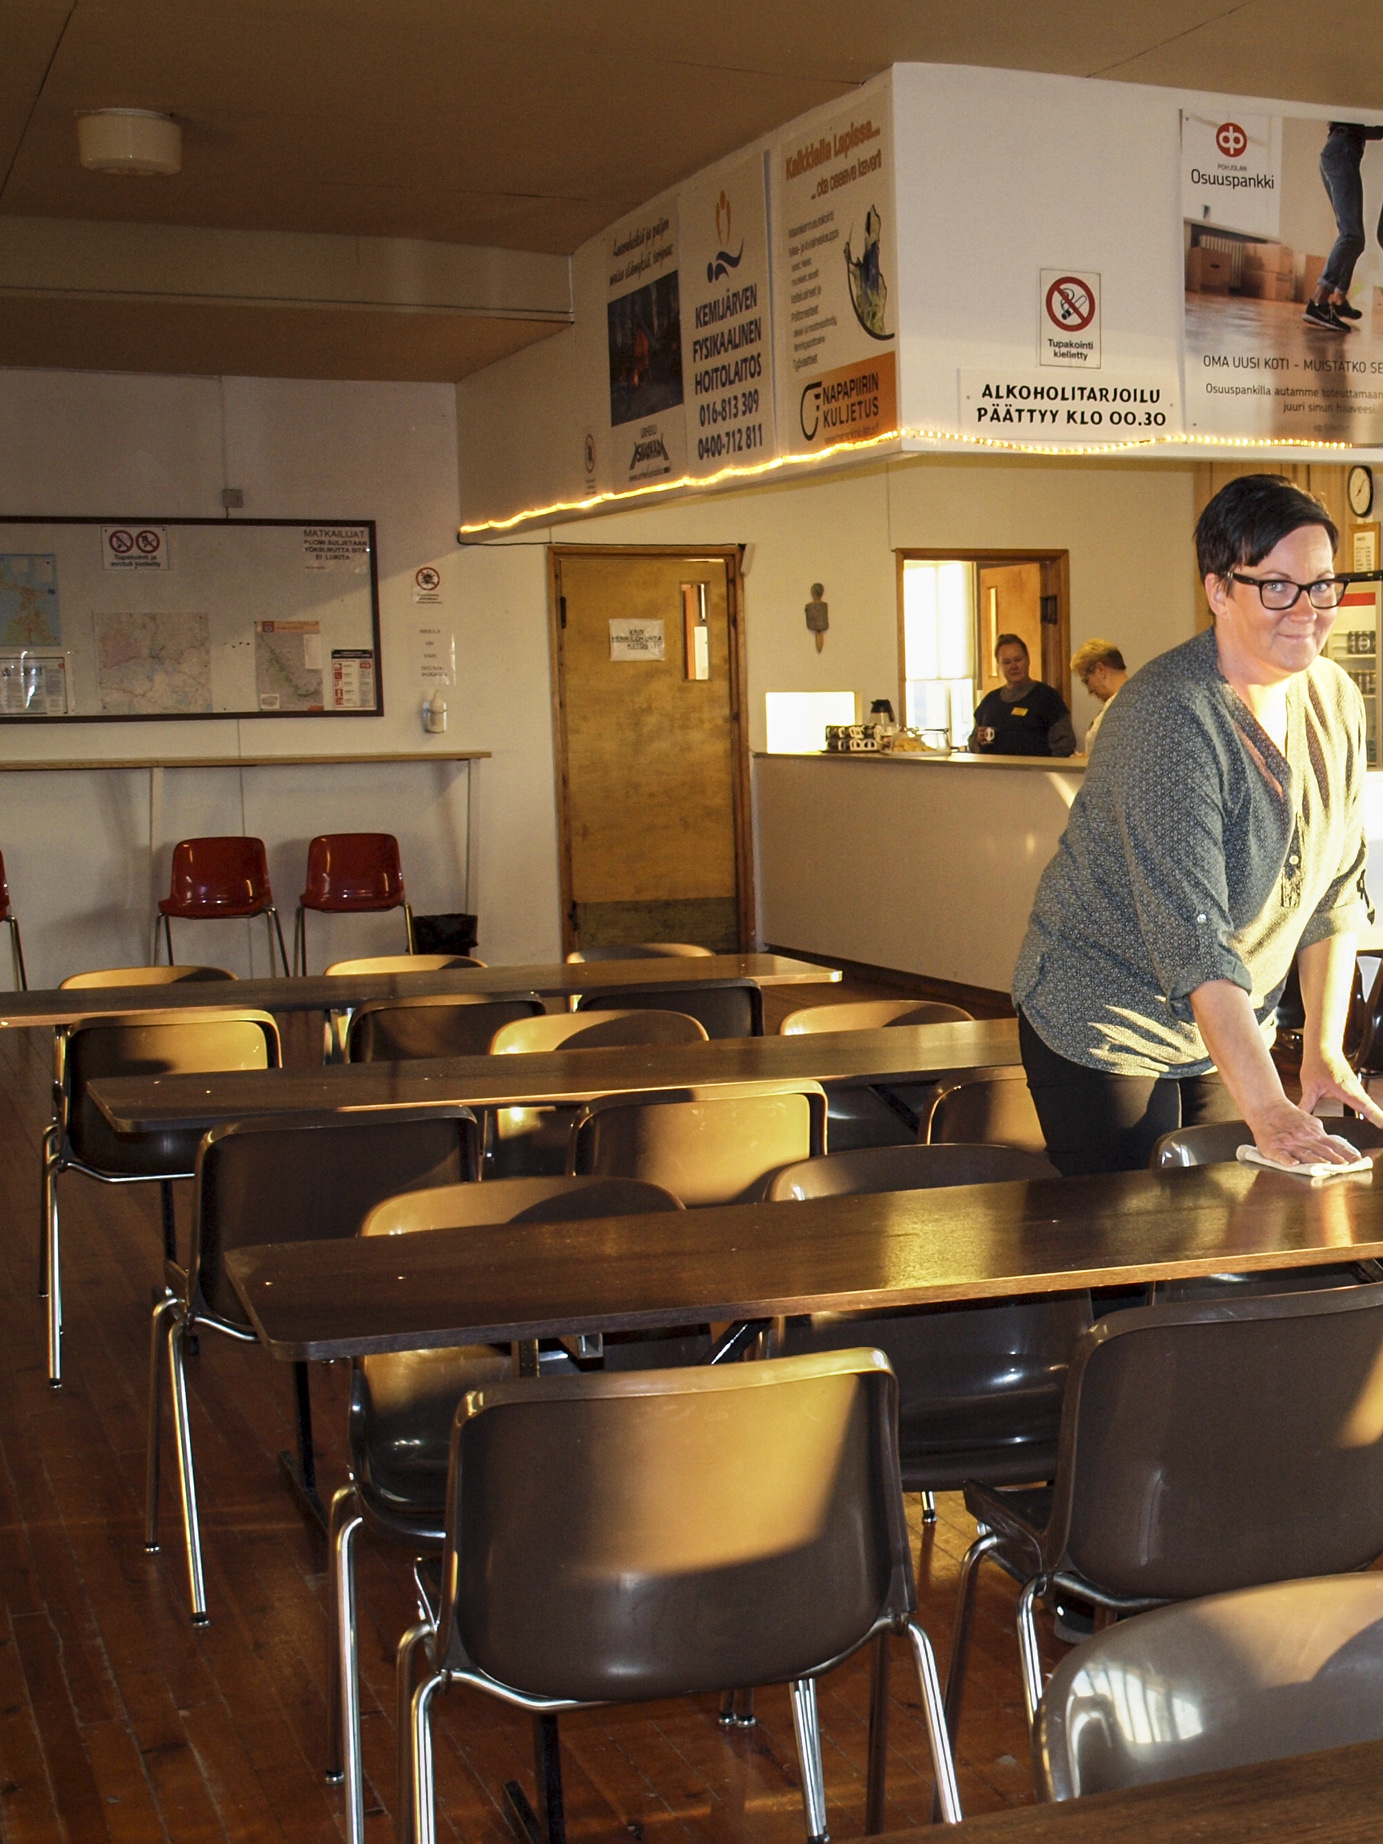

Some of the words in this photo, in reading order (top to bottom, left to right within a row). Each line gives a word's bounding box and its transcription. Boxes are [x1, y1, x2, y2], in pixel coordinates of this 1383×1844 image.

[785, 138, 832, 181] Kaikkialla
[1217, 163, 1248, 171] POHJOLAN
[1191, 168, 1275, 190] Osuuspankki
[695, 283, 758, 329] KEMIJÄRVEN
[693, 317, 762, 364] FYSIKAALINEN
[1048, 338, 1094, 350] Tupakointi
[1053, 350, 1088, 361] kielletty
[1203, 354, 1230, 368] OMA
[1232, 357, 1261, 369] UUSI
[1264, 358, 1290, 370] KOTI
[1303, 359, 1367, 374] MUISTATKO
[695, 352, 762, 396] HOITOLAITOS
[823, 372, 879, 406] NAPAPIIRIN
[981, 384, 1160, 404] ALKOHOLITARJOILU
[1205, 383, 1271, 397] Osuuspankilla
[1274, 386, 1319, 398] autamme
[1322, 387, 1383, 400] toteuttamaan
[699, 395, 739, 427] 016-813
[742, 389, 759, 417] 309
[823, 396, 879, 429] KULJETUS
[976, 403, 1060, 424] PÄÄTTYY
[1066, 410, 1103, 426] KLO
[1109, 411, 1166, 427] 00.30
[1283, 401, 1305, 413] juuri
[1308, 401, 1333, 413] sinun
[698, 428, 743, 461] 0400-712
[745, 423, 763, 450] 811
[304, 529, 365, 538] MATKAILIJAT
